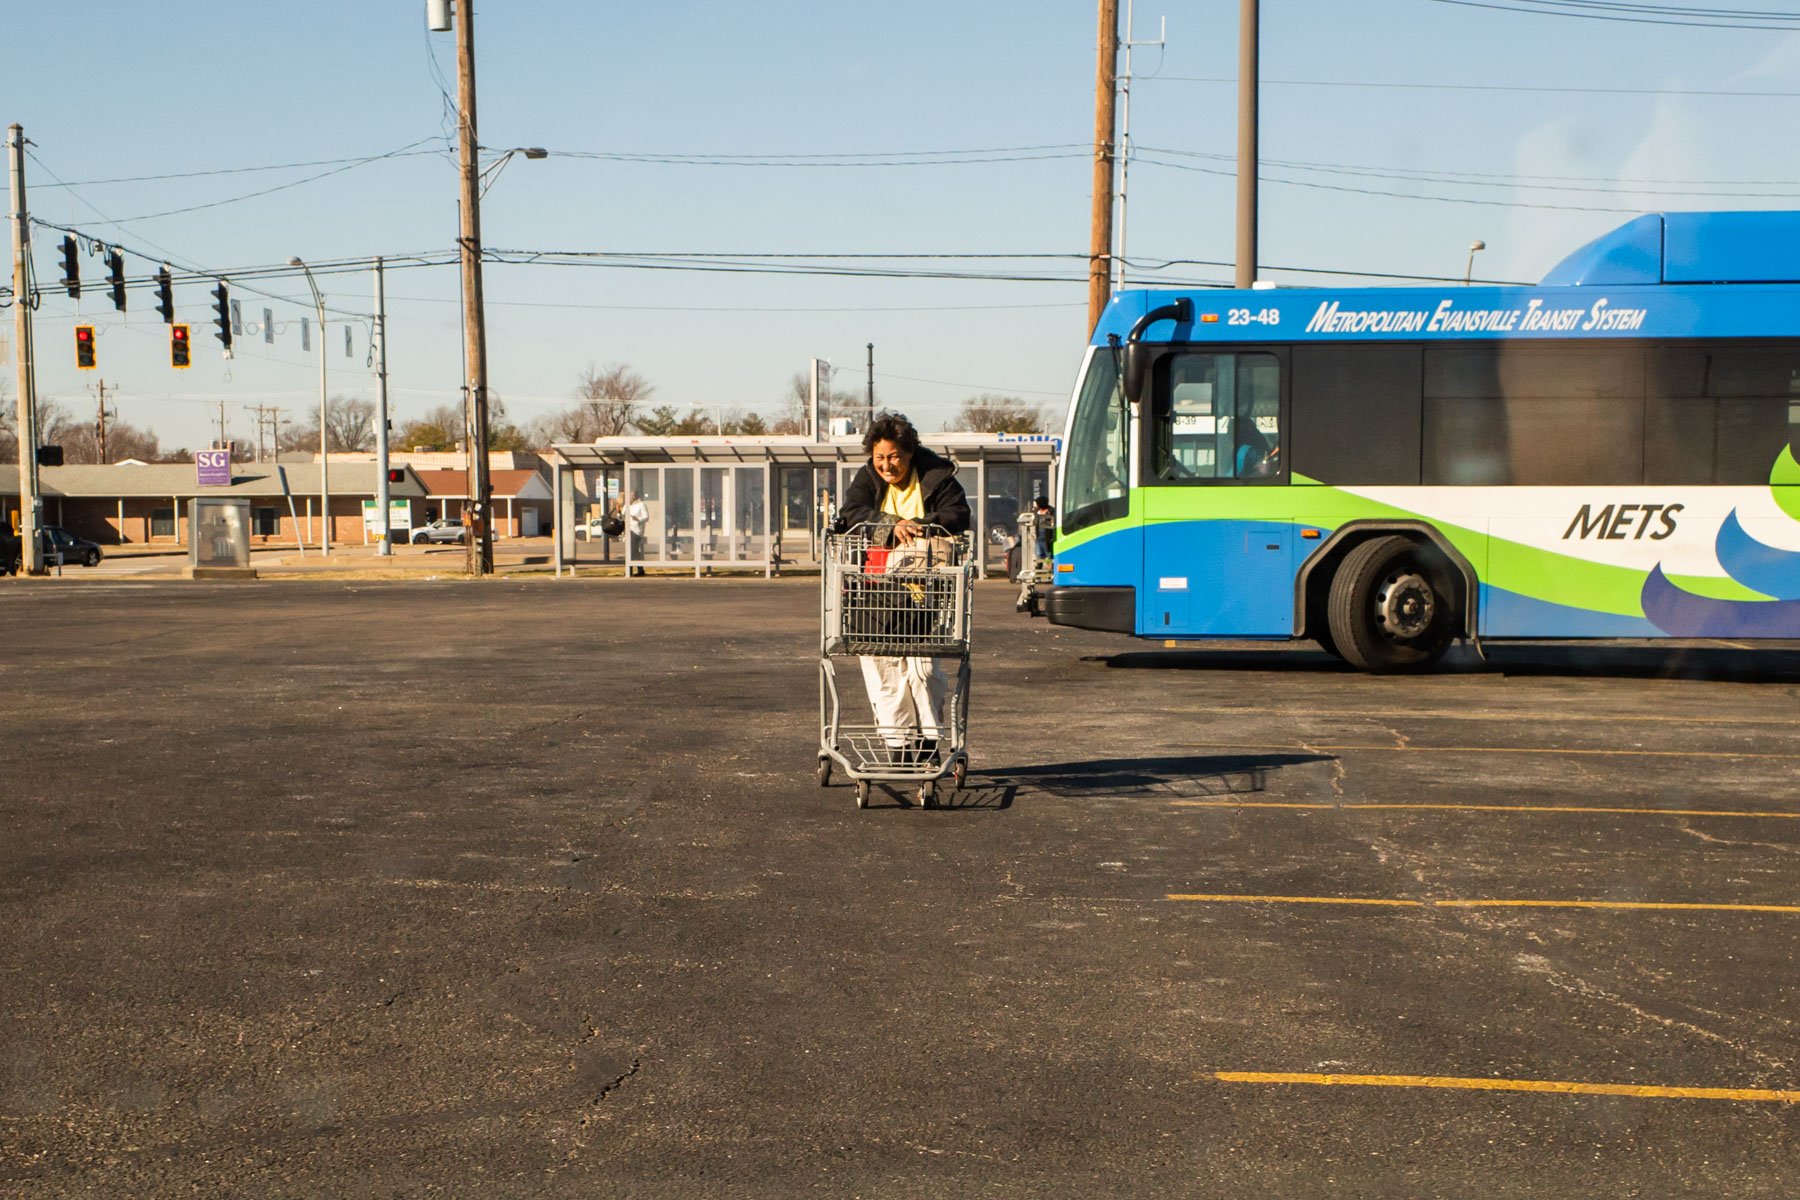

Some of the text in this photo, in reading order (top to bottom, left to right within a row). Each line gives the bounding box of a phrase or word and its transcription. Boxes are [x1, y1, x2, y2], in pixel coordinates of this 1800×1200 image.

[1227, 308, 1280, 325] 23-48
[1305, 298, 1647, 333] METROPOLITAN EVANSVILLE TRANSIT SYSTEM
[198, 452, 226, 468] SG
[1561, 503, 1685, 541] METS
